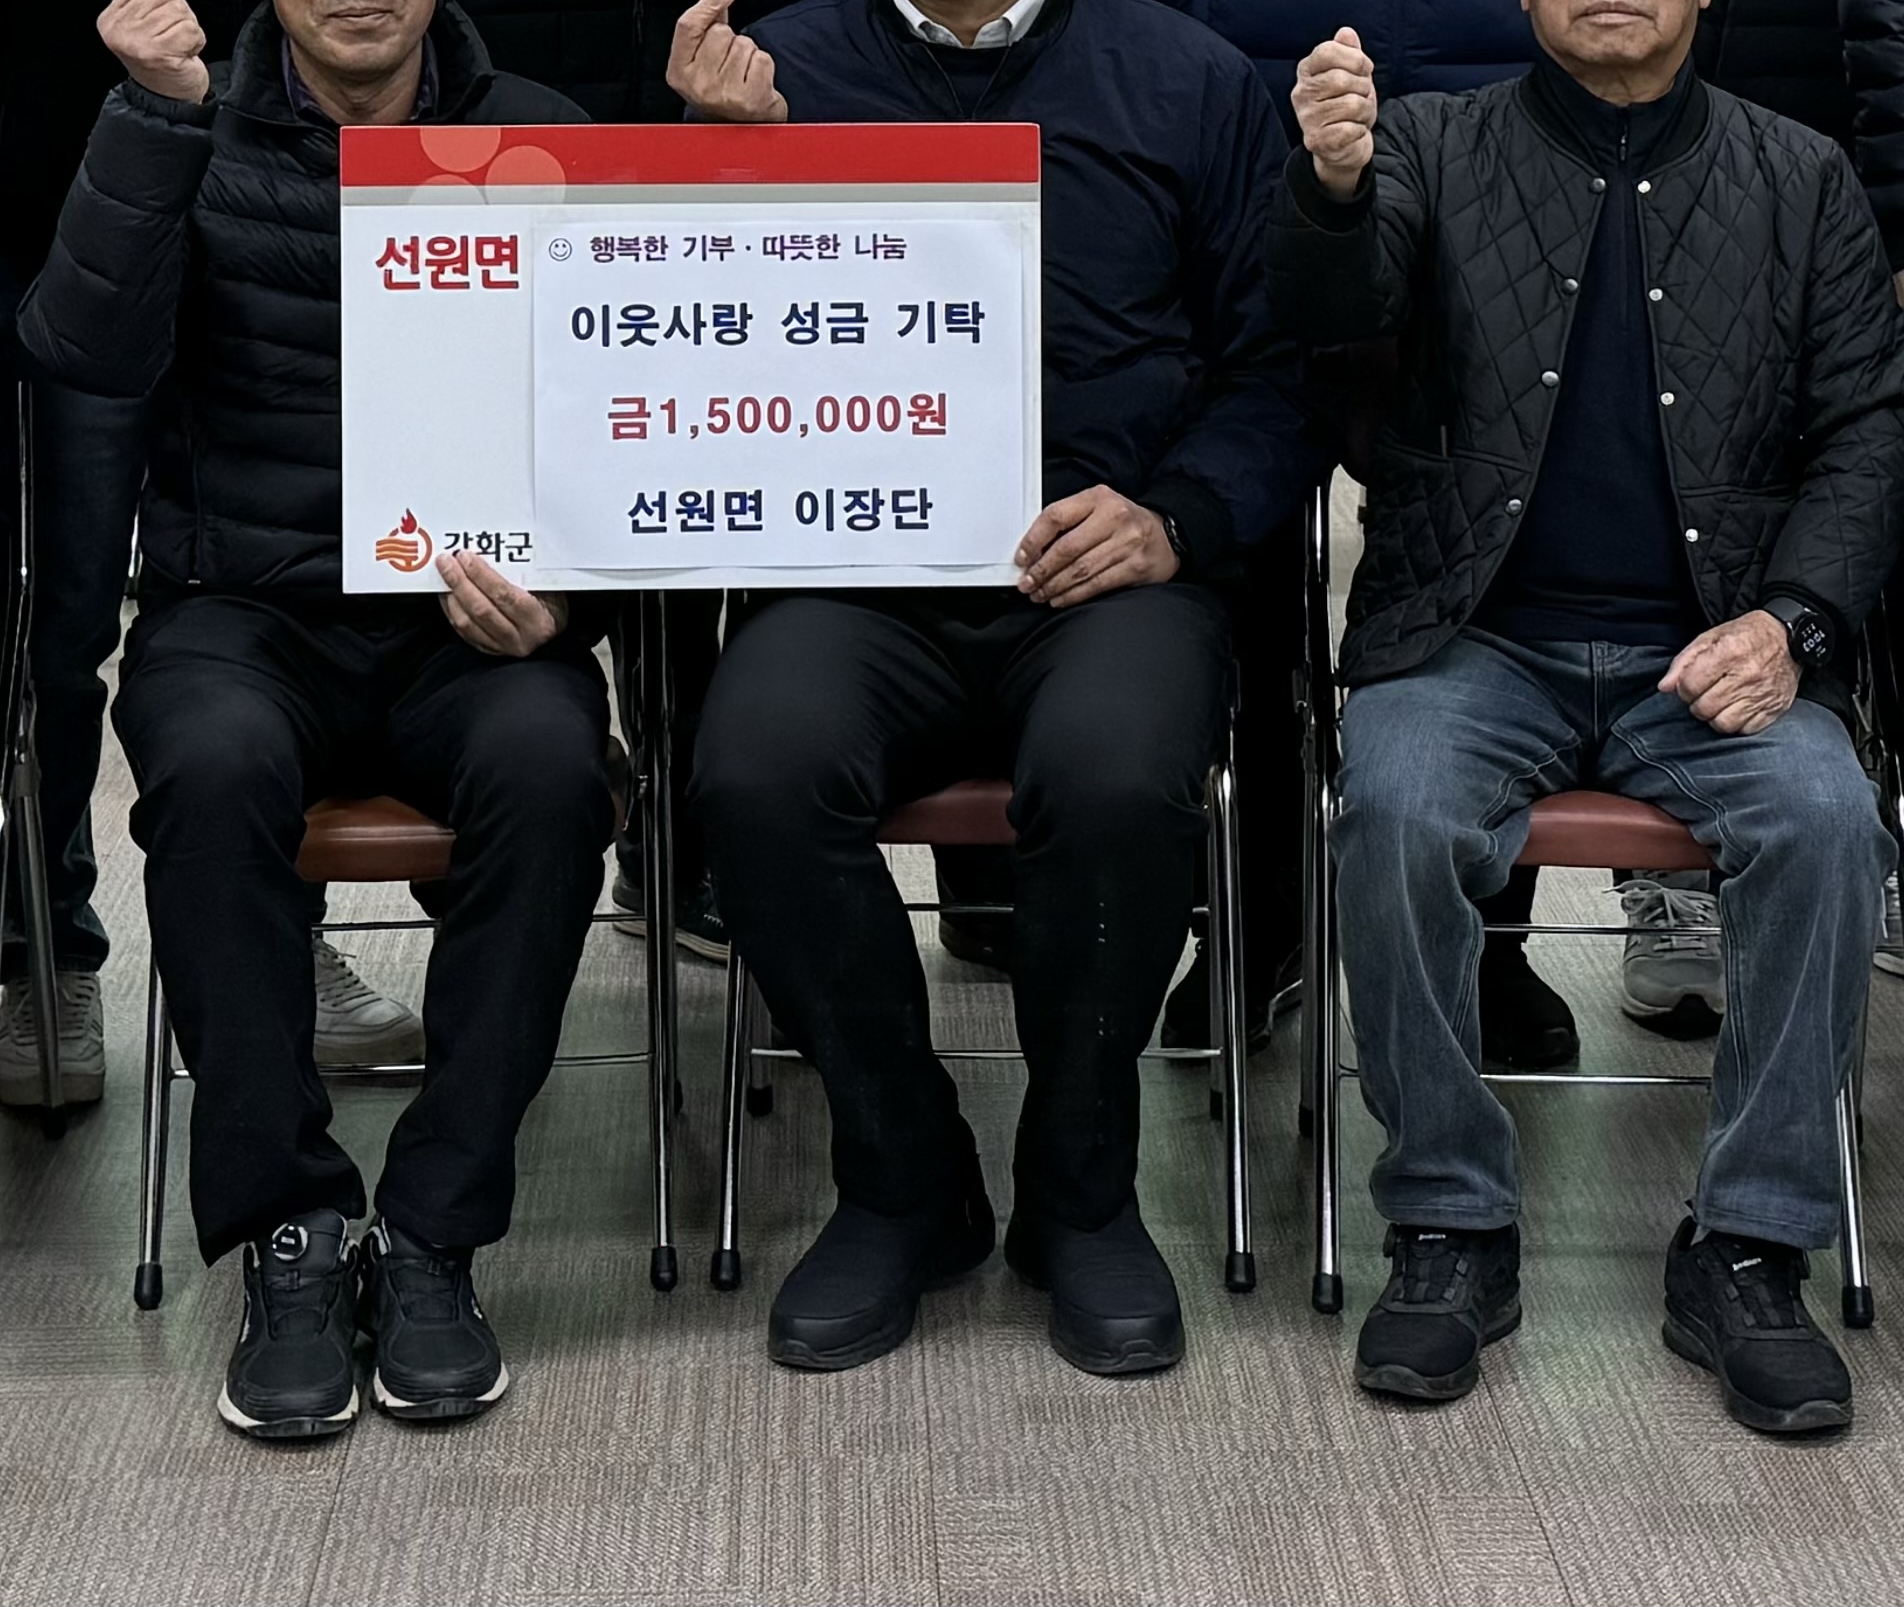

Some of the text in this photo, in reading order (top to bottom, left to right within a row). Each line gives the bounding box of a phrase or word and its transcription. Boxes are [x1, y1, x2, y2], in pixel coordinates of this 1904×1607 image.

[376, 234, 520, 291] 선원면
[590, 234, 908, 263] 행복한 기부 따뜻한 나눔
[571, 301, 987, 349] 이웃사랑 성금 기탁
[608, 393, 948, 441] 금1,500,000원
[628, 488, 934, 535] 선원면 이장단
[444, 530, 533, 563] 강화군
